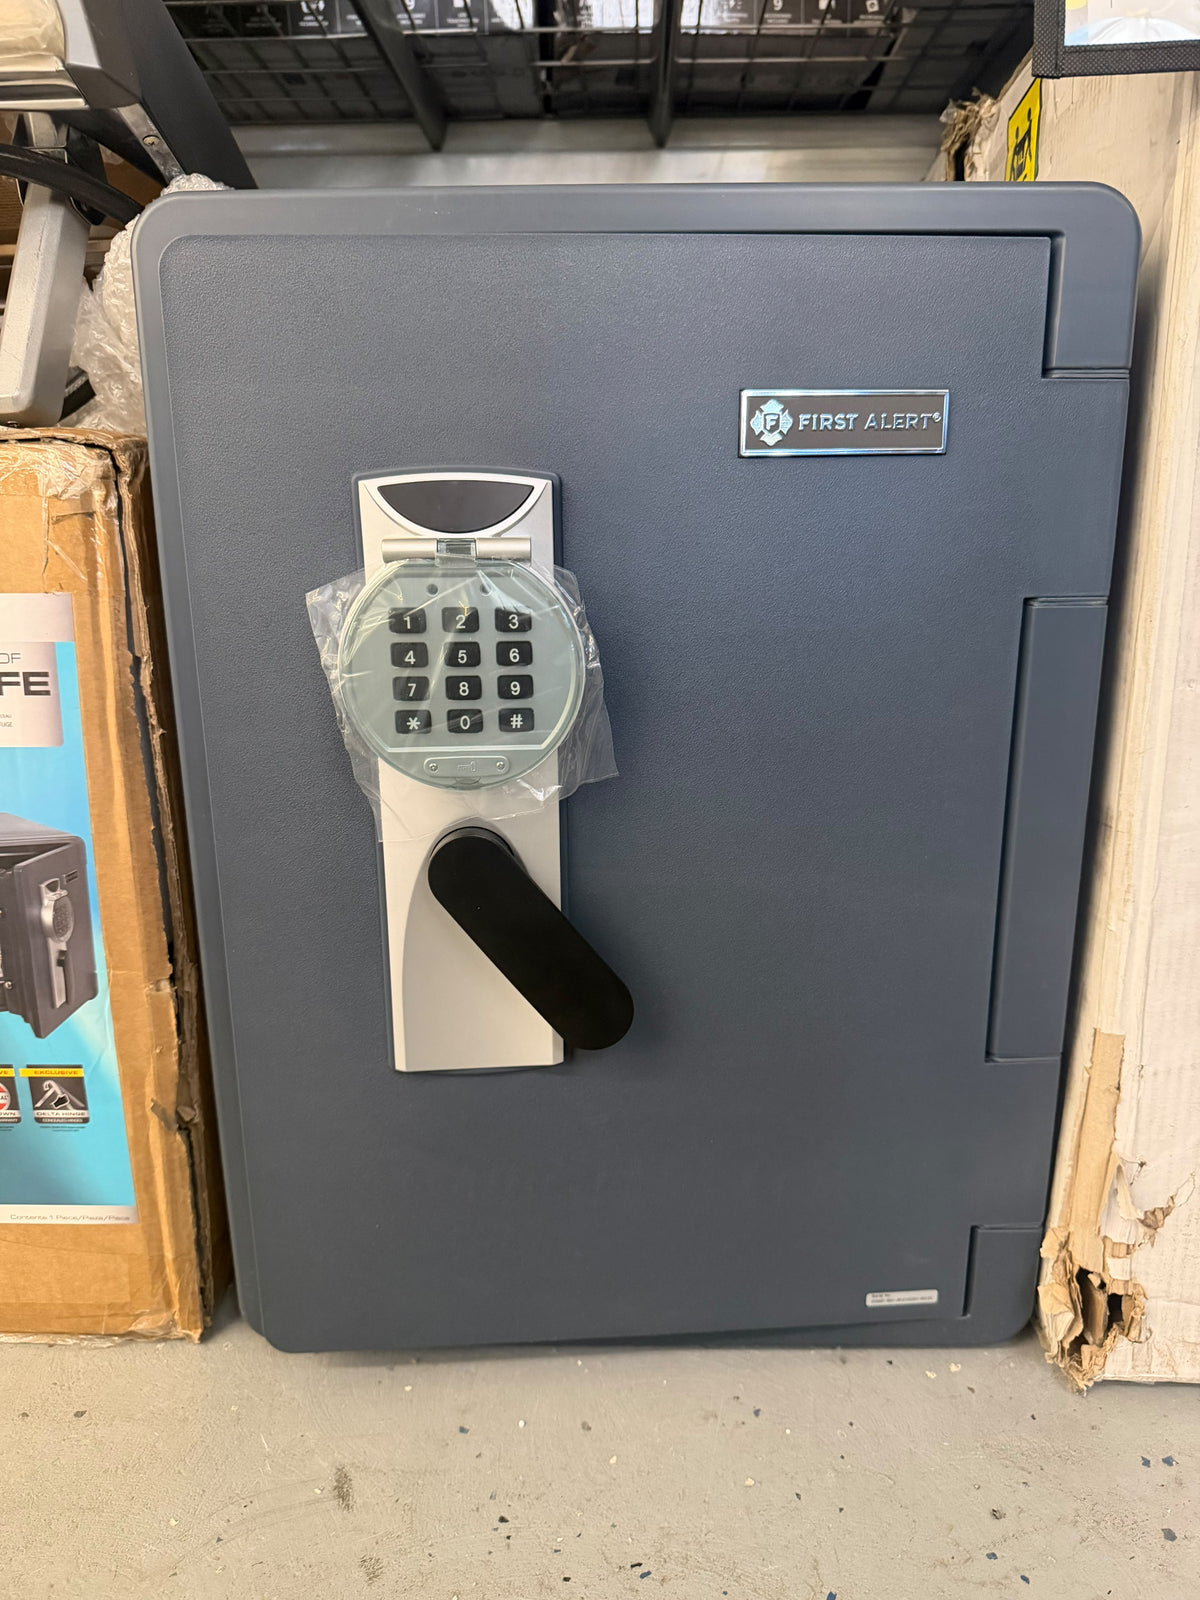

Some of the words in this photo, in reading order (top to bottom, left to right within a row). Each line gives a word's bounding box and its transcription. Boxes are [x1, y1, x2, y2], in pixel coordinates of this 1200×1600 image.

[798, 412, 858, 431] FIRST
[403, 616, 411, 630] 1
[456, 614, 466, 629] 2
[508, 614, 519, 630] 3
[404, 650, 416, 665] 4
[457, 650, 468, 664] 5
[509, 648, 520, 663] 6
[407, 683, 417, 697] 7
[459, 681, 469, 696] 8
[510, 681, 521, 696] 9
[460, 715, 470, 730] 0
[510, 714, 523, 729] #
